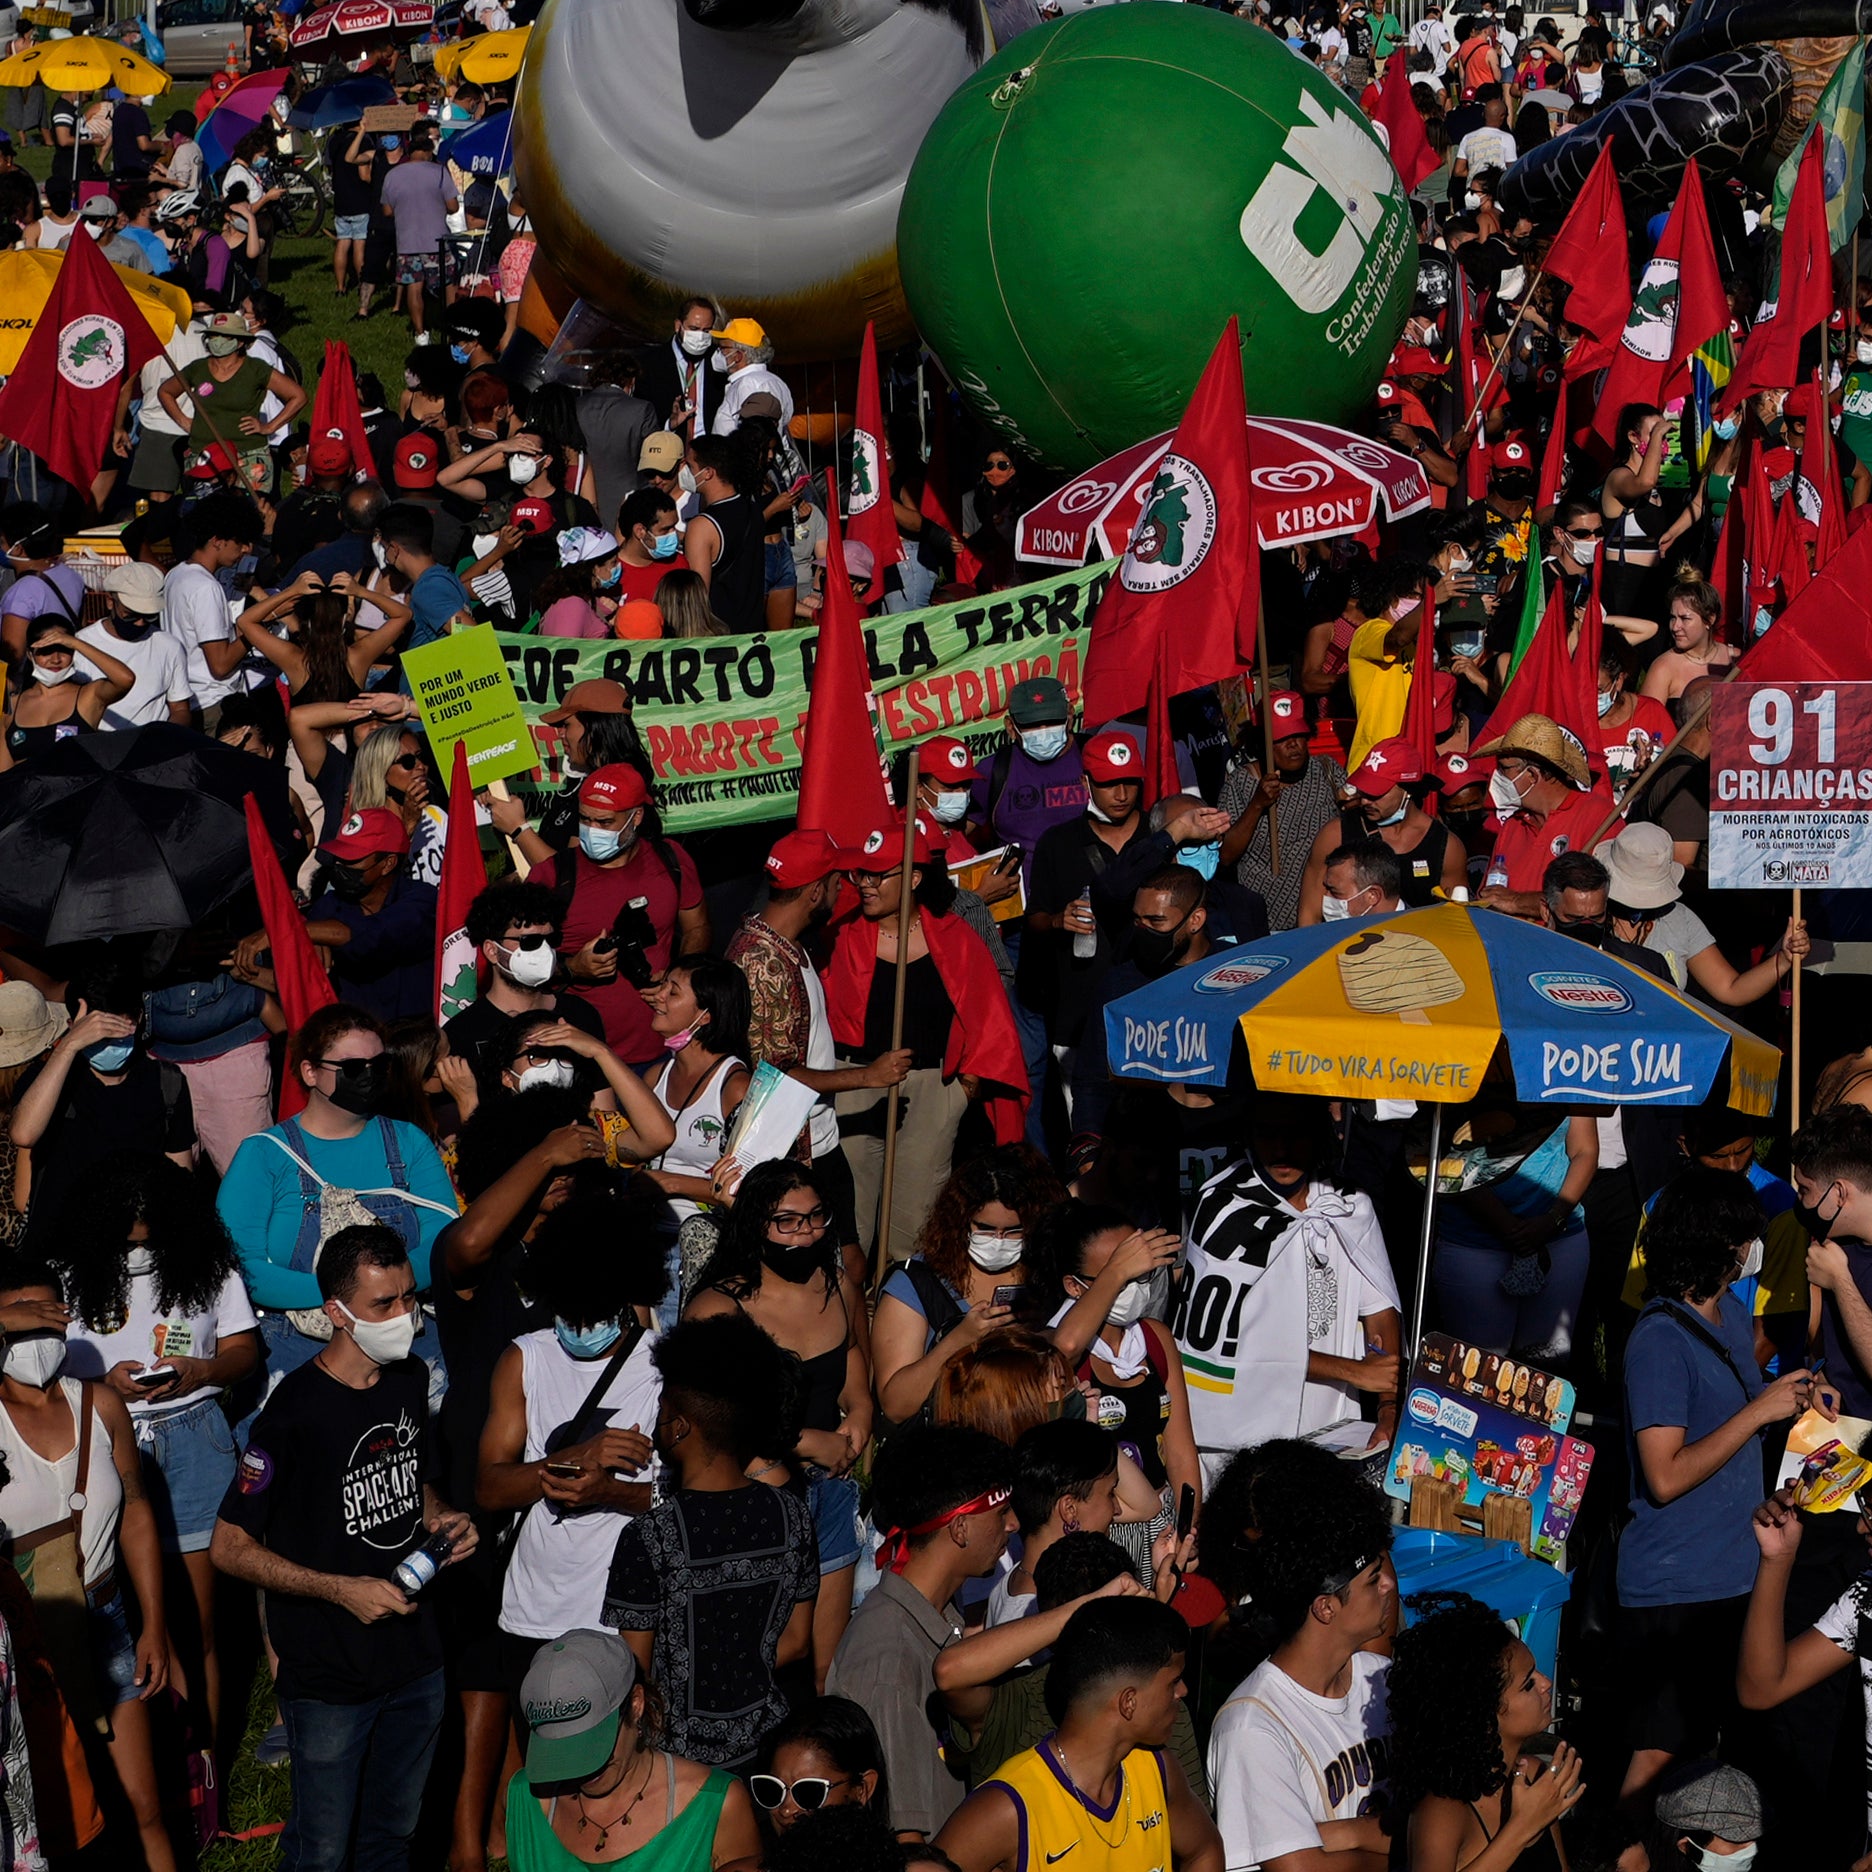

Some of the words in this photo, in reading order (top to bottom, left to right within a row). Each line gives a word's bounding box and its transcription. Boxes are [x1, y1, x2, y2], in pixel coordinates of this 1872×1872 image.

[344, 15, 383, 29] KIBON
[400, 11, 427, 21] KIBON
[297, 27, 323, 41] KIBON
[471, 155, 494, 173] BOA
[1325, 210, 1400, 343] Confederação
[1337, 227, 1412, 357] Trabalhadores
[1177, 458, 1217, 540] TRABALHADORES
[1391, 478, 1417, 507] KIBON
[516, 508, 539, 516] MST
[1276, 497, 1356, 534] KIBON
[1032, 528, 1076, 554] KIBON
[1187, 540, 1209, 576] RURAIS
[1126, 579, 1158, 591] TERRA
[1159, 568, 1182, 590] SEM
[419, 675, 444, 694] POR
[446, 668, 464, 684] UM
[603, 632, 777, 715] BARTÔ
[424, 685, 466, 710] MUNDO
[466, 671, 503, 695] VERDE
[430, 712, 438, 725] E
[438, 698, 474, 721] JUSTO
[1746, 687, 1837, 766] 91
[466, 738, 519, 766] EENPEACE
[648, 715, 784, 780] PACOTE
[593, 781, 618, 794] MST
[1047, 787, 1089, 808] MAT
[1722, 813, 1790, 825] MORRERAM
[1793, 813, 1870, 825] INTOXICADAS
[1742, 828, 1766, 839] POR
[1769, 826, 1851, 841] AGROTÓXICOS
[1755, 842, 1769, 850] NOS
[1771, 840, 1805, 850] ÚLTIMOS
[1807, 842, 1817, 850] 10
[1818, 842, 1837, 850] ANOS
[1790, 859, 1830, 868] AGROTÓXICO
[1790, 866, 1830, 882] MATA
[1207, 966, 1265, 987] Nestlé
[1541, 974, 1600, 986] SORVETES
[1549, 985, 1623, 1004] Nestlé
[1124, 1016, 1171, 1062] PODE
[1175, 1016, 1208, 1063] SIM
[1267, 1051, 1334, 1075] #TUDO
[1338, 1055, 1384, 1080] VIRA
[1389, 1056, 1471, 1088] SORVETE
[1542, 1040, 1622, 1086] PODE
[1630, 1038, 1681, 1086] SIM
[1439, 1408, 1471, 1434] SORVETE
[343, 1469, 394, 1521] SPACE
[346, 1494, 420, 1536] CHALLENE
